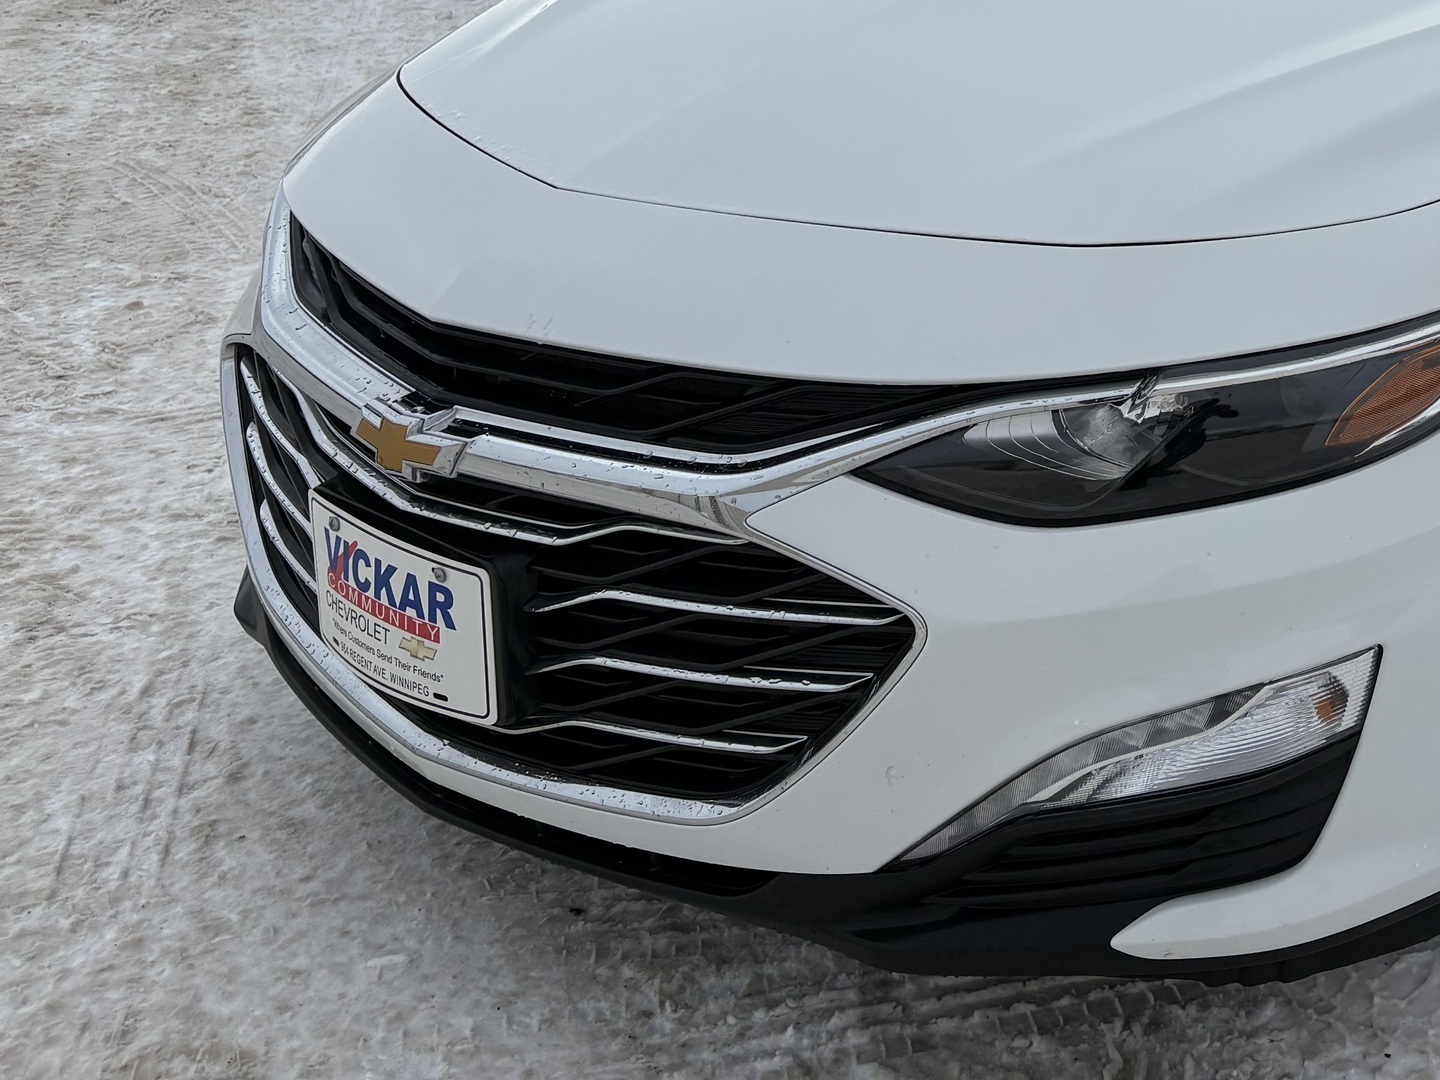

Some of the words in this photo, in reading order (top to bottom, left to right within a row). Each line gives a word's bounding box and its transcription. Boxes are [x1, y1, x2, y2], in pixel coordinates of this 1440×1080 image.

[324, 526, 457, 631] VICKAR
[327, 572, 439, 641] COMMUNITY
[326, 589, 391, 645] CHEVROLET
[347, 630, 376, 656] Customers
[376, 648, 393, 665] Send
[394, 656, 411, 672] Their
[349, 649, 373, 671] REGENT
[389, 671, 430, 697] WINNIPEG
